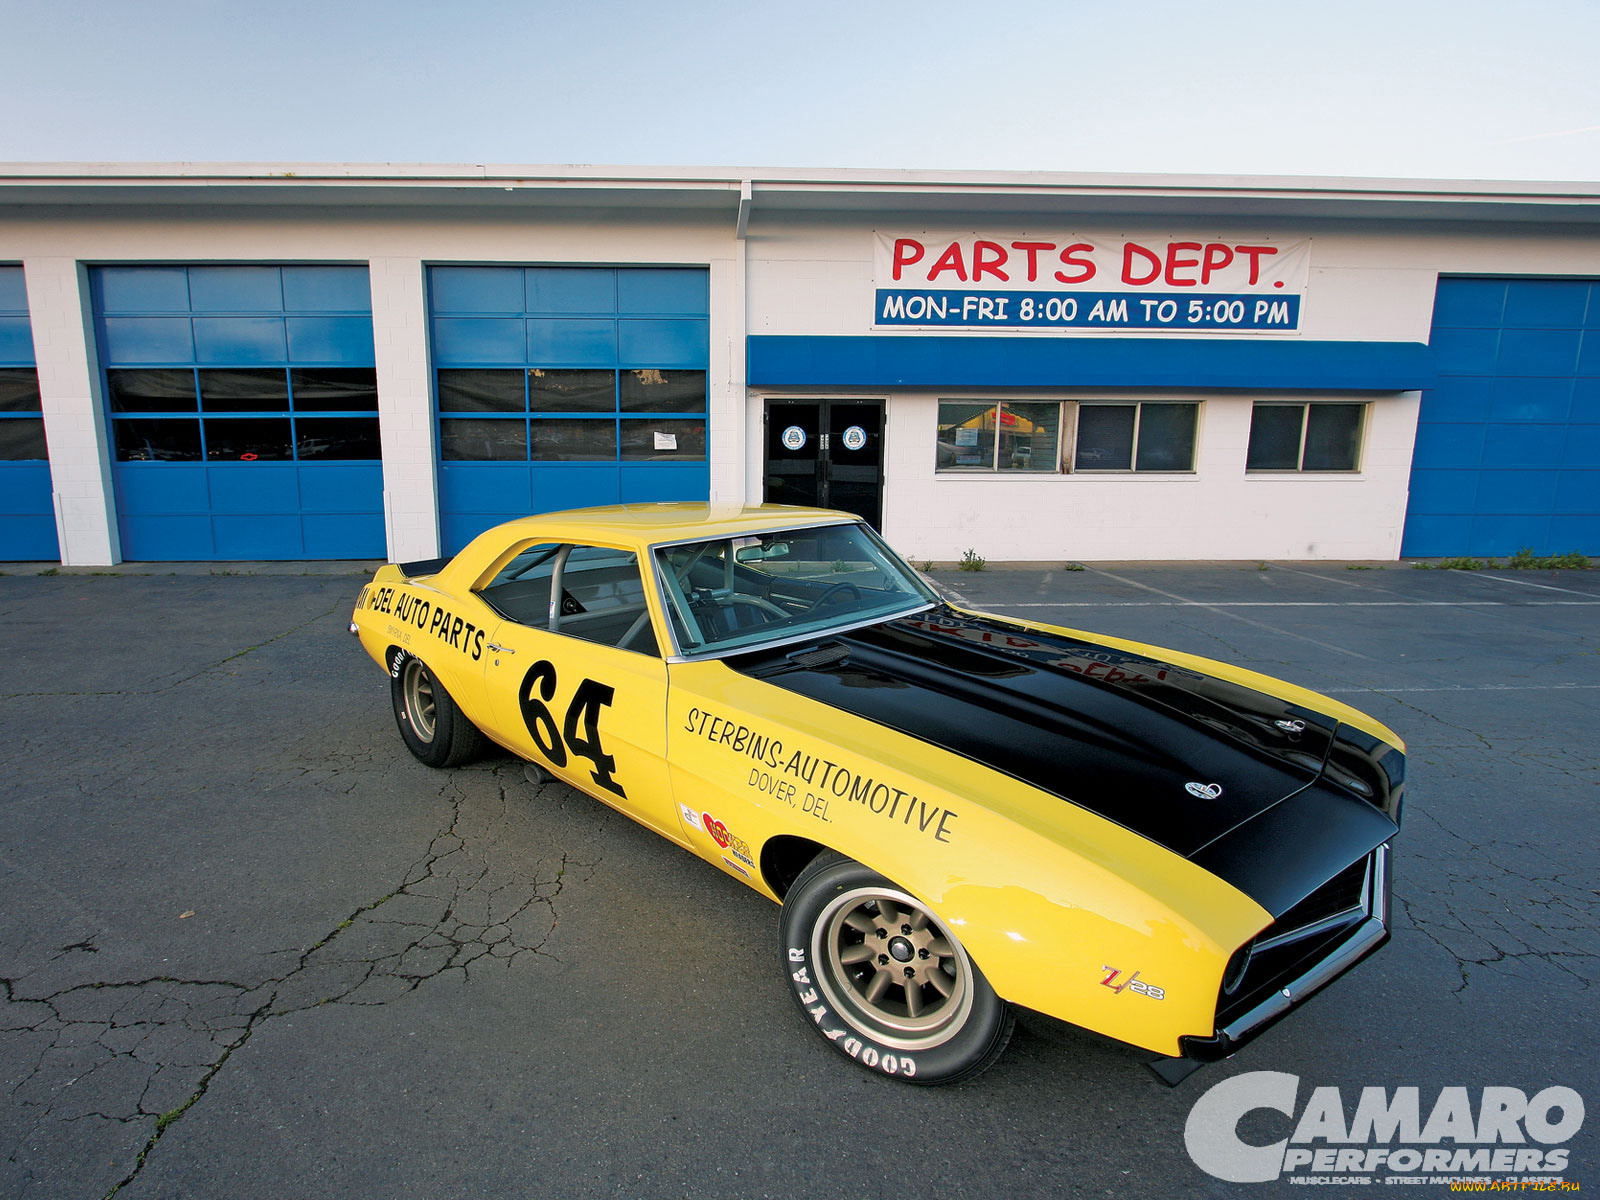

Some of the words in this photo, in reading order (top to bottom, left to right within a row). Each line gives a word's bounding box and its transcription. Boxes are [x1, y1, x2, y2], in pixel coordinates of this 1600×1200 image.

[892, 238, 1097, 284] PARTS
[1121, 242, 1285, 289] DEPT.
[882, 295, 1009, 321] MON-FRI
[1019, 297, 1078, 322] 8:00
[1088, 299, 1129, 323] AM
[1140, 299, 1177, 323] TO
[1187, 300, 1245, 324] 5:00
[1254, 301, 1290, 325] PM
[394, 592, 430, 630] AUTO
[429, 606, 486, 662] PARTS
[518, 659, 629, 800] 64
[684, 707, 959, 843] STERBINS-AUTOMOTIVE
[748, 768, 797, 808] DOVER,
[802, 793, 833, 824] DEL.
[1100, 965, 1166, 1000] Z/28
